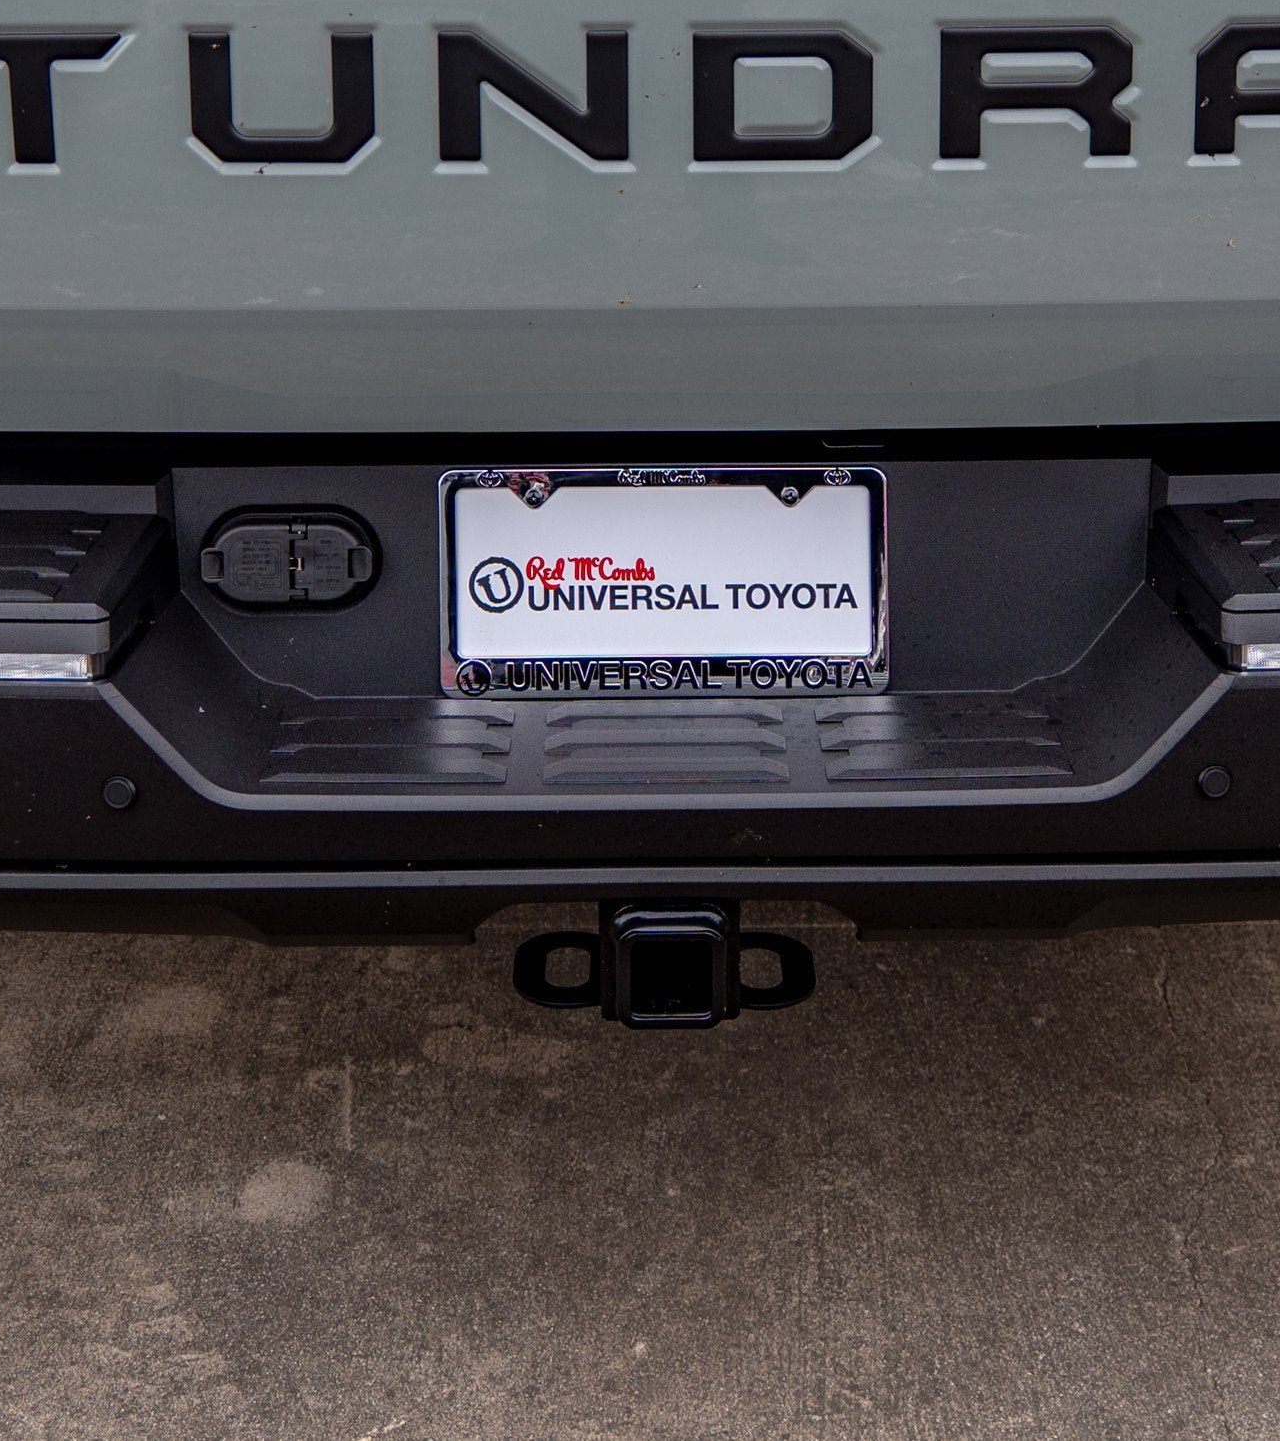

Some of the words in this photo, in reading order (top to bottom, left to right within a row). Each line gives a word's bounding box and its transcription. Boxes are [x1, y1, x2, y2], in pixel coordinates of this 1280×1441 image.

[525, 555, 566, 590] Red
[568, 556, 657, 582] McCombs
[527, 583, 719, 611] UNIVERSAL
[724, 582, 859, 610] TOYOTA
[506, 659, 723, 691] UNIVERSAL
[726, 658, 874, 689] TOYOTA
